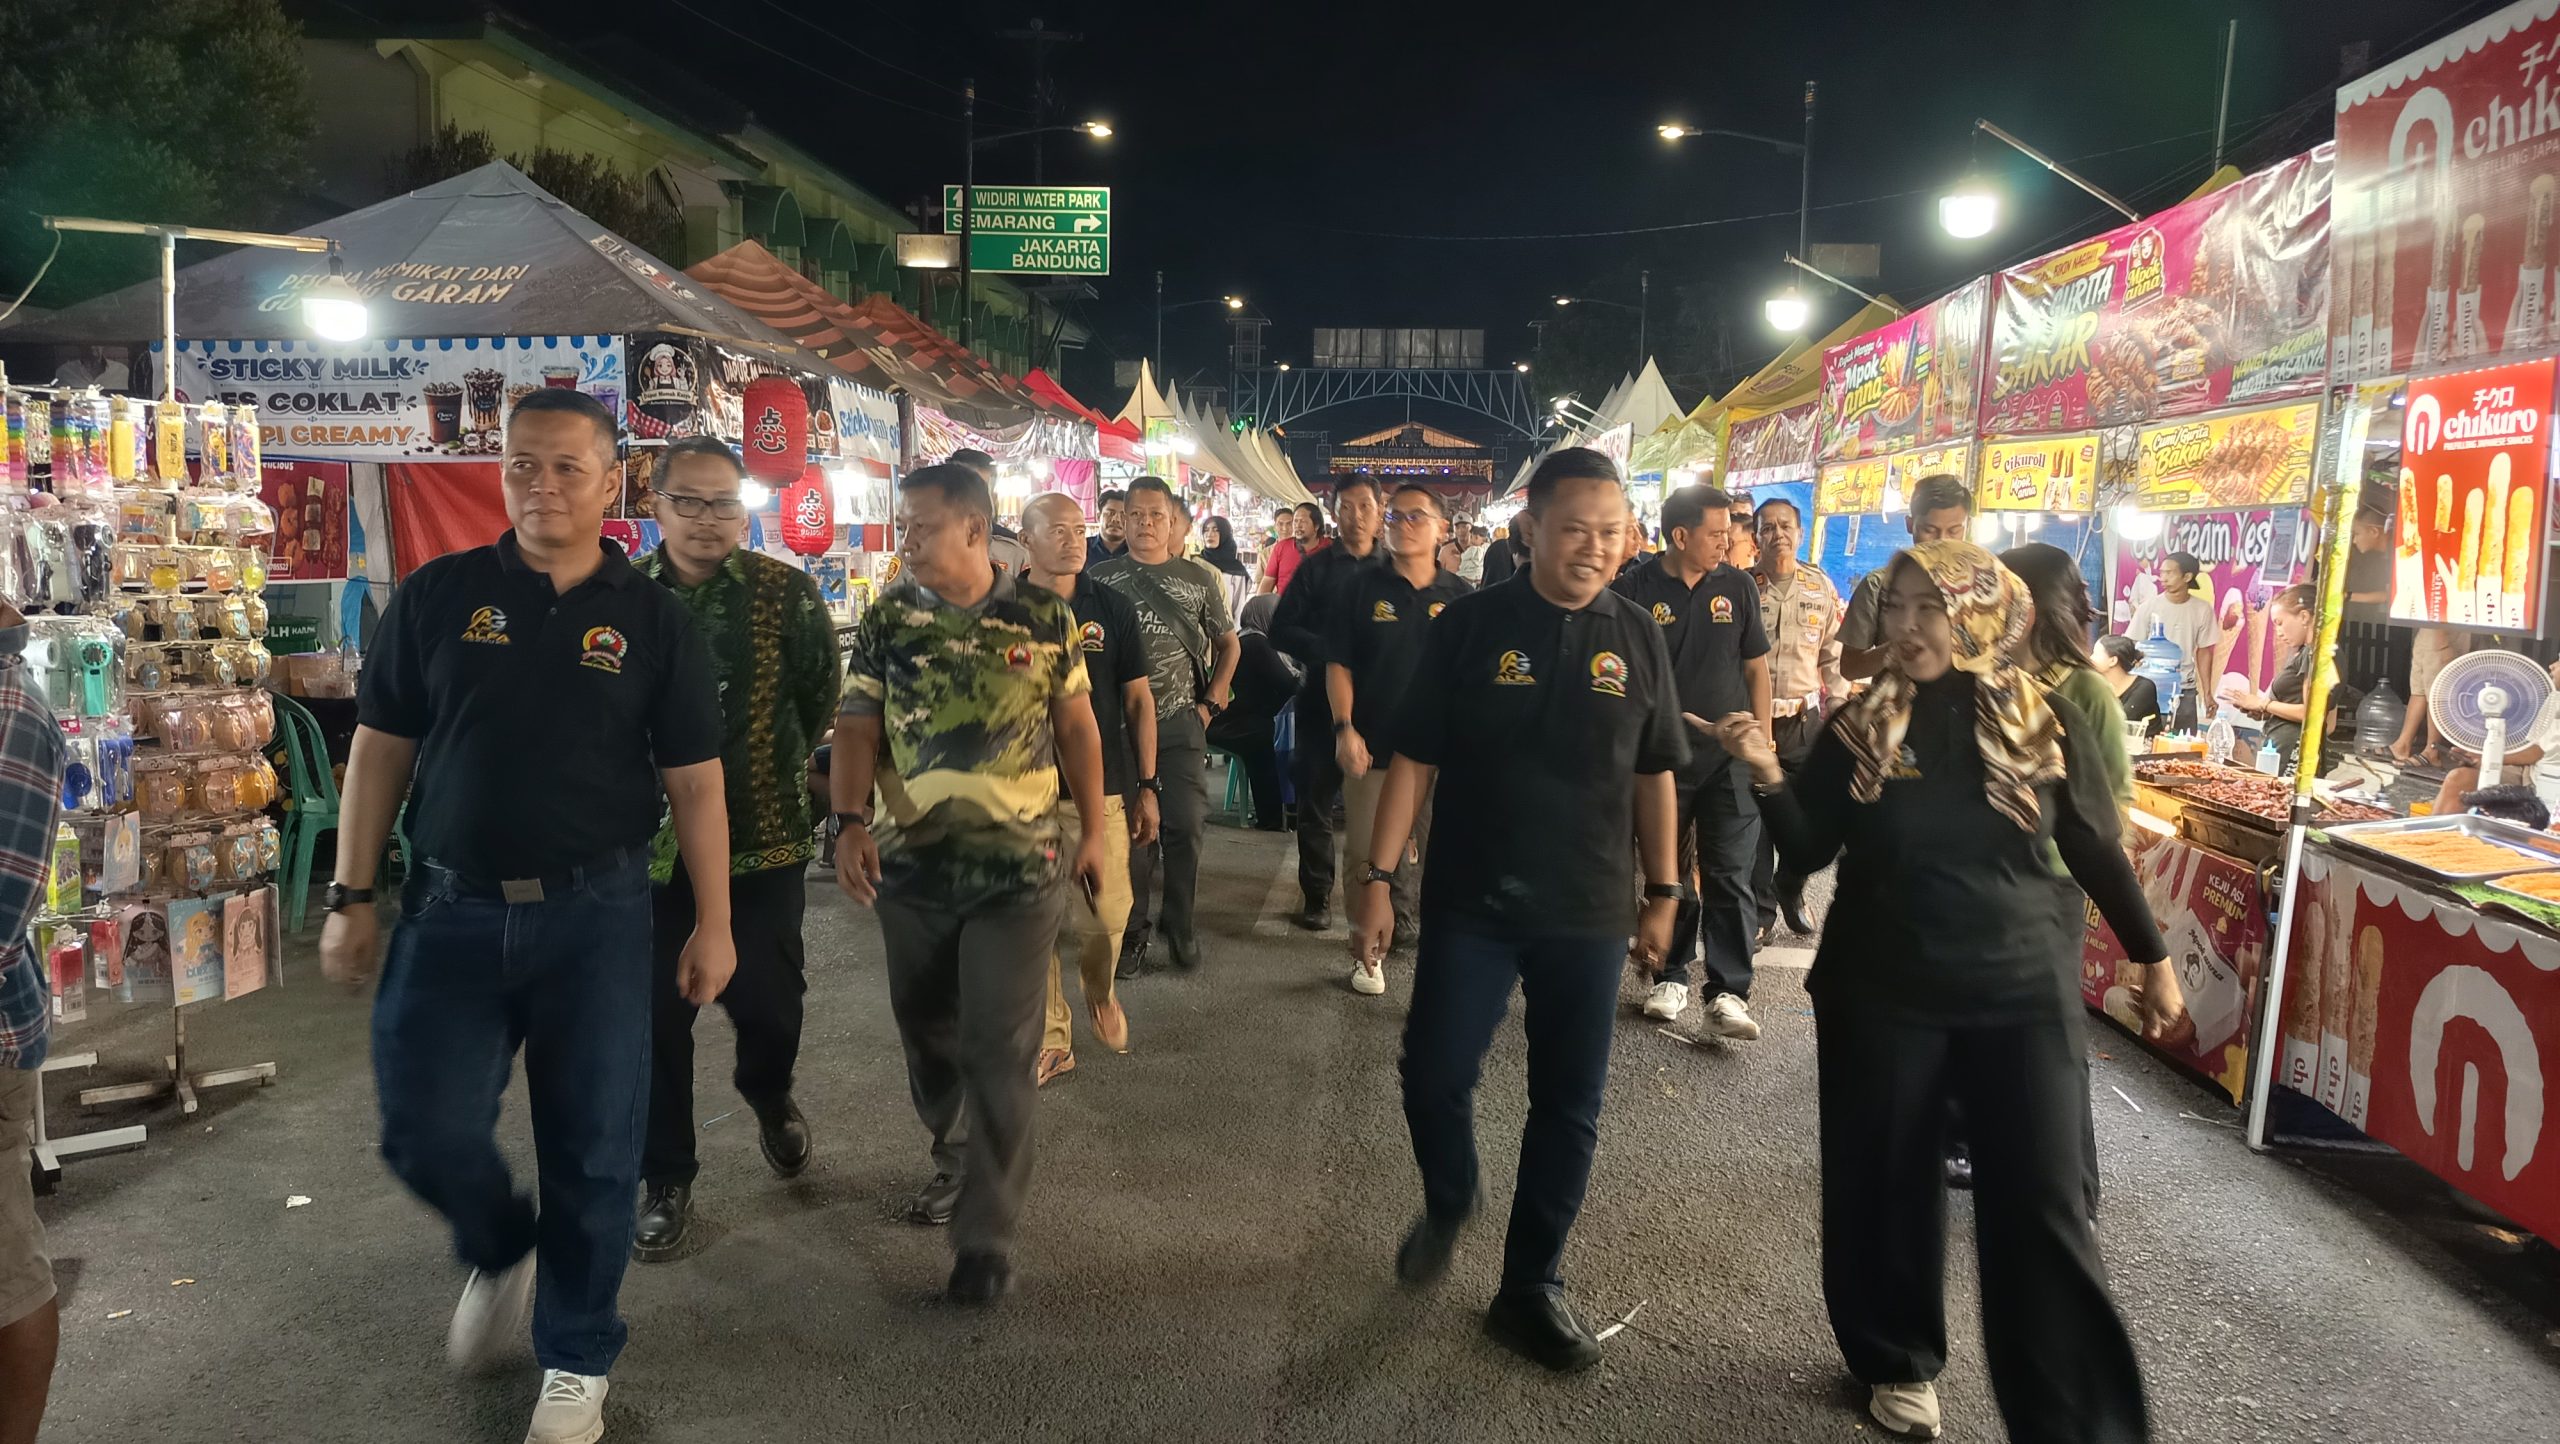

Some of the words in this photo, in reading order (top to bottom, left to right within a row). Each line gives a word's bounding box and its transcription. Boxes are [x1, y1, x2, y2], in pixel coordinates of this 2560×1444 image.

[976, 191, 1020, 206] WIDURI
[1023, 192, 1065, 207] WATER
[1069, 193, 1101, 208] PARK
[1019, 239, 1100, 253] JAKARTA
[467, 264, 530, 282] DARI
[1012, 254, 1101, 269] BANDUNG
[391, 280, 514, 304] GARAM
[210, 357, 327, 378] STICKY
[333, 357, 411, 378] MILK
[1844, 353, 1880, 394] Mpok
[267, 392, 401, 412] COKLAT
[1844, 376, 1883, 420] anna
[2473, 386, 2515, 410] チクロ
[2443, 406, 2538, 440] chikuro
[290, 425, 414, 445] CREAMY
[2155, 439, 2212, 477] Bakar
[2208, 873, 2231, 895] KEJU
[2188, 929, 2206, 957] Mpok
[2203, 955, 2225, 982] anna
